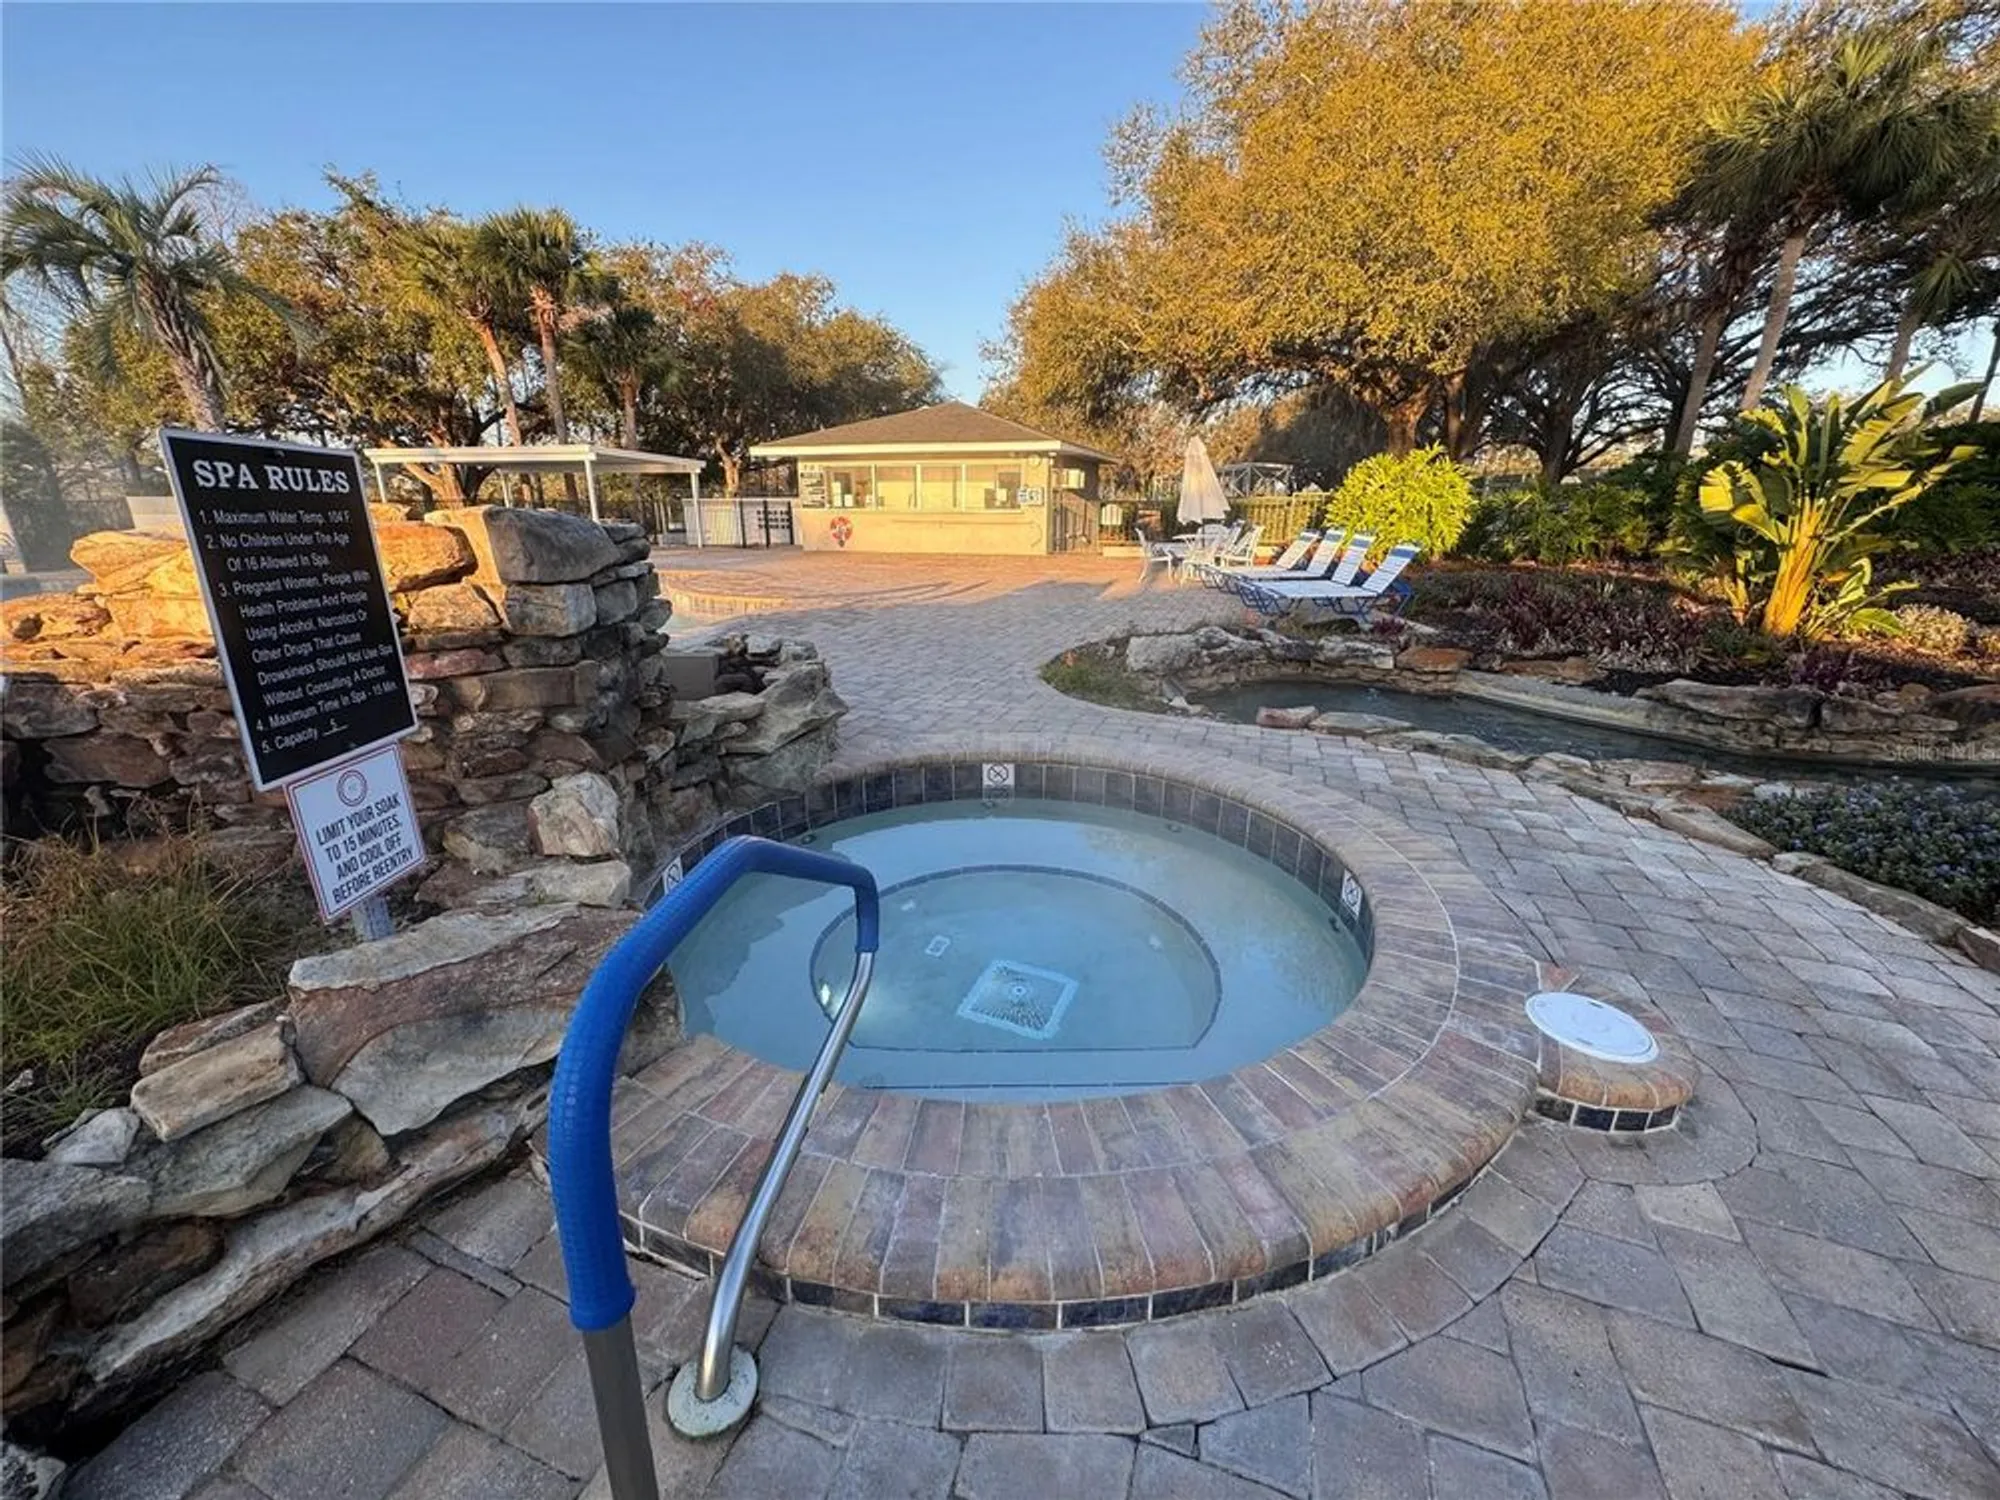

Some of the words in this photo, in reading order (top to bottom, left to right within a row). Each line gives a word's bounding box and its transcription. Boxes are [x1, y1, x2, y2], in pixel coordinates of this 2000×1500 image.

[193, 460, 259, 489] SPA
[264, 465, 350, 493] RULES
[199, 510, 211, 524] 1.
[213, 509, 267, 523] Maximum
[268, 511, 298, 523] Water
[205, 535, 218, 549] 2.
[220, 534, 237, 547] No
[240, 534, 284, 546] Children
[285, 533, 314, 545] Under
[314, 532, 331, 543] The
[334, 532, 350, 546] Age
[227, 557, 242, 571] Of
[260, 555, 299, 568] Allowed
[300, 554, 309, 566] In
[218, 583, 230, 597] 3.
[232, 579, 282, 597] Pregnant
[322, 573, 351, 586] People
[352, 570, 370, 582] With
[239, 602, 275, 618] Health
[276, 597, 321, 612] Problems
[322, 595, 339, 606] And
[340, 591, 368, 604] People
[245, 625, 278, 641] Using
[317, 613, 356, 627] Narcotics
[357, 610, 367, 621] Or
[252, 648, 281, 663] Other
[283, 641, 313, 657] Drugs
[313, 635, 333, 648] That
[334, 632, 361, 645] Cause
[258, 663, 315, 686] Drowsiness
[316, 654, 347, 672] Should
[346, 651, 362, 663] Not
[362, 649, 378, 659] Use
[378, 644, 393, 656] Spa
[263, 686, 304, 706] Without
[306, 676, 353, 696] Consulting
[353, 671, 360, 682] A
[360, 665, 386, 680] Doctor
[268, 706, 318, 728] Maximum
[318, 699, 340, 712] Time
[340, 695, 351, 706] In
[350, 690, 367, 704] Spa
[261, 740, 273, 754] 5.
[274, 728, 318, 749] Capacity
[316, 818, 346, 845] LIMIT
[346, 805, 375, 829] YOUR
[374, 792, 401, 817] SOAK
[326, 844, 341, 863] TO
[343, 835, 357, 854] 15
[337, 856, 359, 880] AND
[358, 843, 385, 867] COOL
[384, 832, 401, 852] OFF
[332, 869, 372, 903] BEFORE
[372, 846, 413, 880] REENTRY
